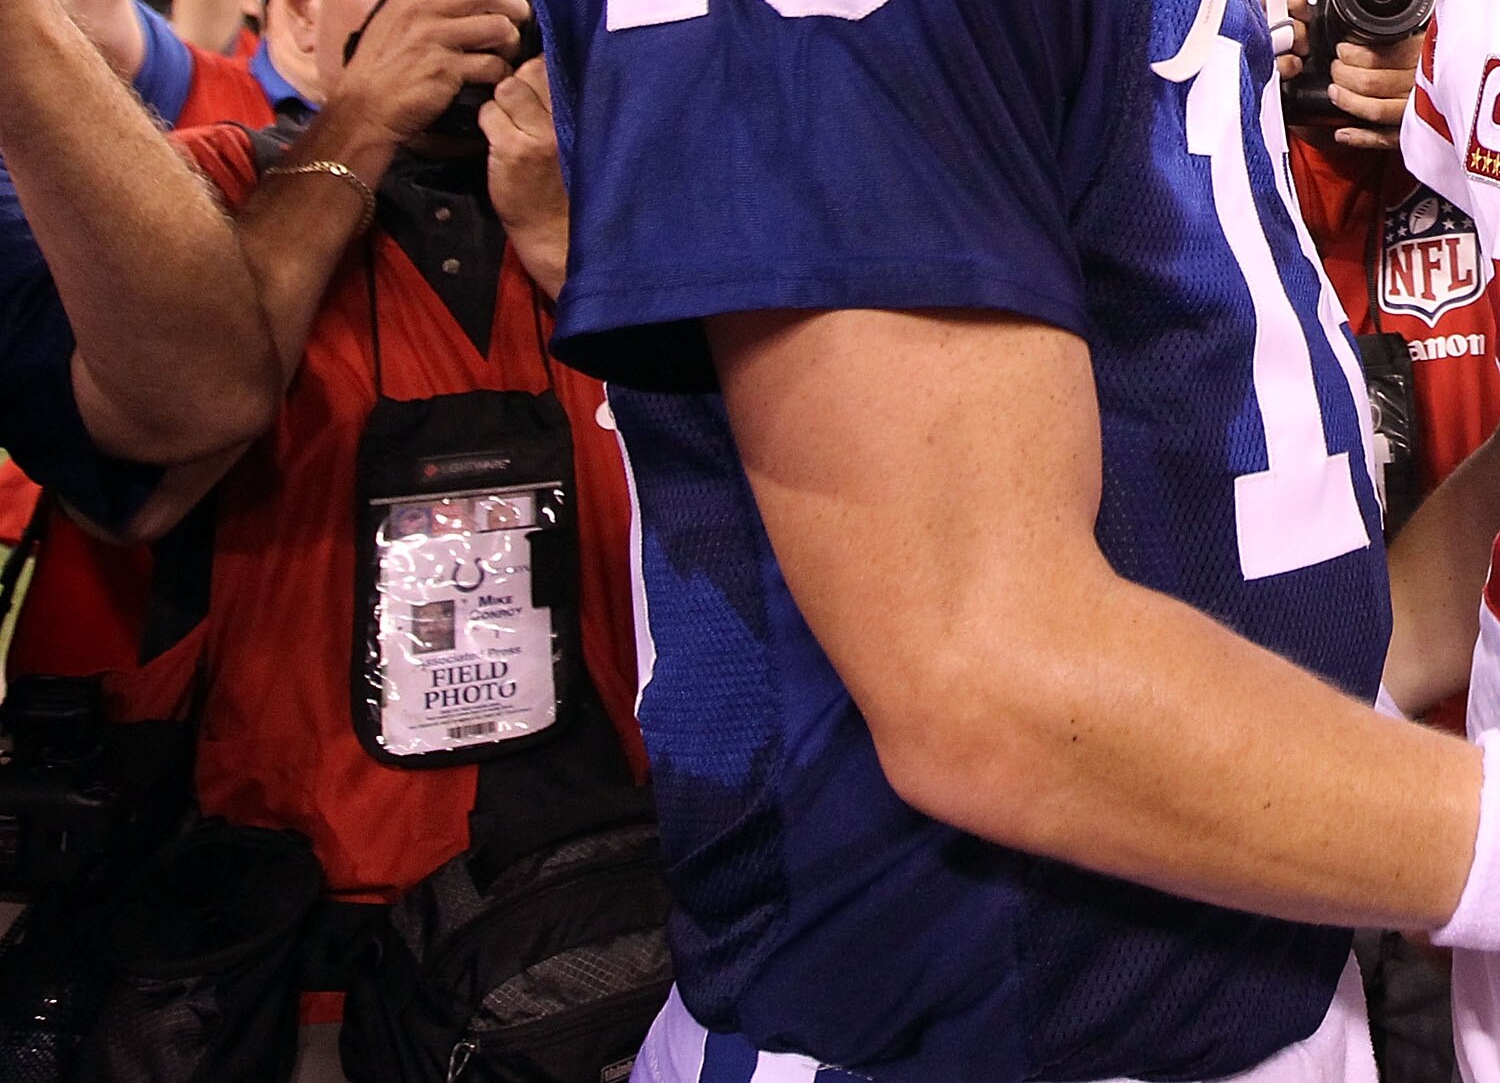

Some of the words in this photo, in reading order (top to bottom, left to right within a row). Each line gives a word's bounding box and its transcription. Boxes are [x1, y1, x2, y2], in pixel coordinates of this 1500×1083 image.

[1388, 237, 1474, 302] NFL
[1407, 334, 1486, 362] anon
[432, 661, 509, 687] FIELD
[424, 681, 517, 710] PHOTO
